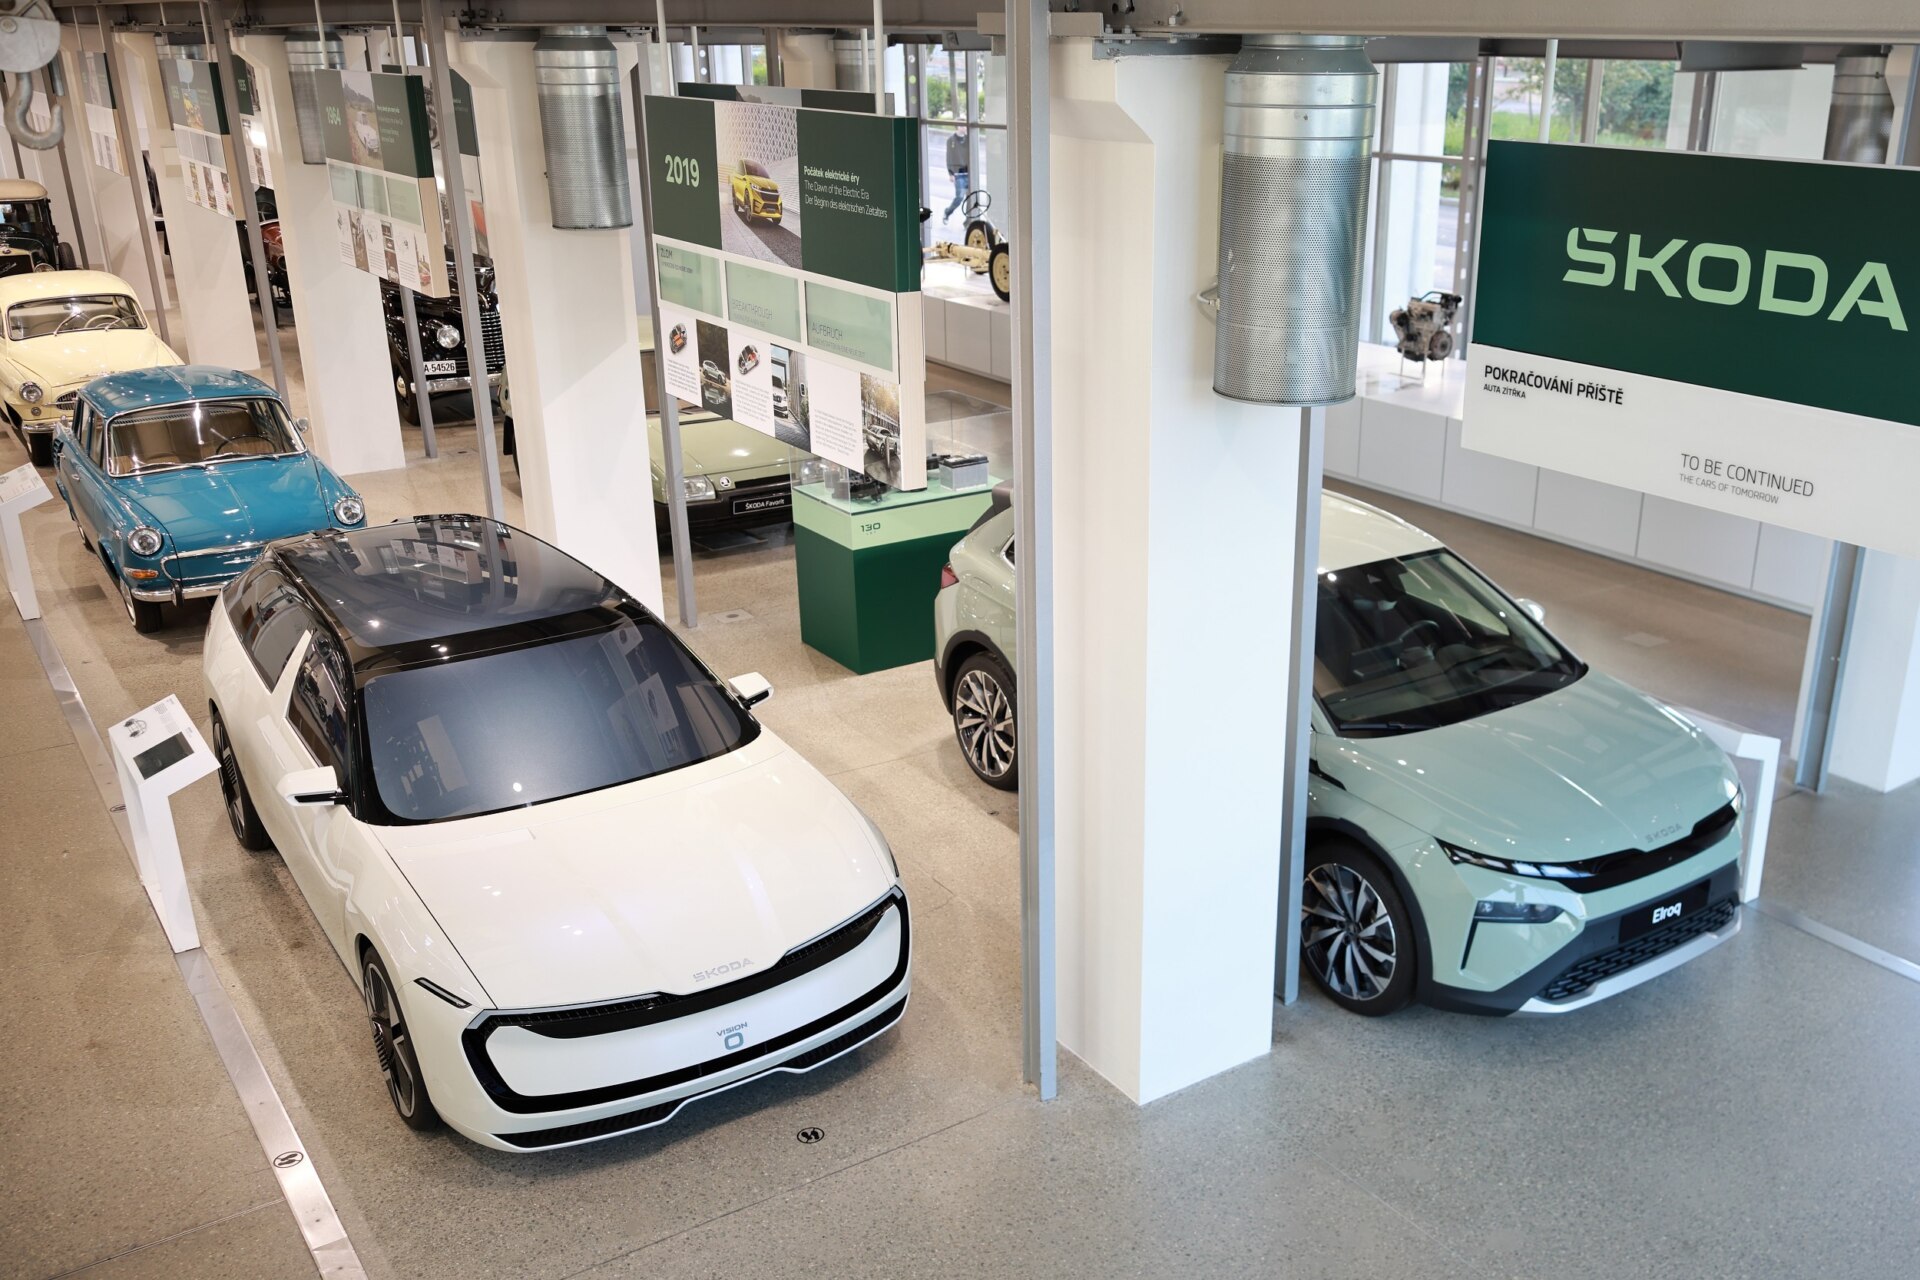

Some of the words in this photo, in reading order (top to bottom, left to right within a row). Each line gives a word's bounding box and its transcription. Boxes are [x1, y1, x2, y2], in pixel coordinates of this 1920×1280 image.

[664, 154, 700, 188] 2019
[803, 165, 824, 178] Počátek
[824, 168, 850, 182] elektrické
[850, 172, 860, 186] éry
[804, 180, 814, 191] The
[814, 181, 828, 193] Dawn
[829, 184, 834, 194] of
[834, 185, 842, 196] the
[842, 186, 860, 199] Electric
[861, 189, 869, 200] Era
[804, 194, 814, 205] Der
[814, 195, 830, 209] Beginn
[830, 199, 838, 210] des
[838, 201, 865, 214] elektrischen
[865, 204, 888, 219] Zeitalters
[1483, 383, 1501, 394] AUTA
[1502, 386, 1527, 399] ZÍTŘKA
[1484, 365, 1574, 395] POKRAČOVÁNÍ
[1576, 381, 1624, 405] PŘÍŠTĚ
[1681, 453, 1700, 471] TO
[1704, 458, 1723, 477] BE
[1726, 464, 1814, 497] CONTINUED
[1680, 473, 1694, 485] THE
[1695, 477, 1717, 490] CARS
[1718, 482, 1729, 492] OF
[1731, 485, 1779, 504] TOMORROW
[745, 502, 765, 510] ŠKODA
[765, 498, 785, 507] Favorit
[860, 522, 881, 533] 130
[1652, 902, 1682, 924] Elroq
[716, 1021, 748, 1037] VISION
